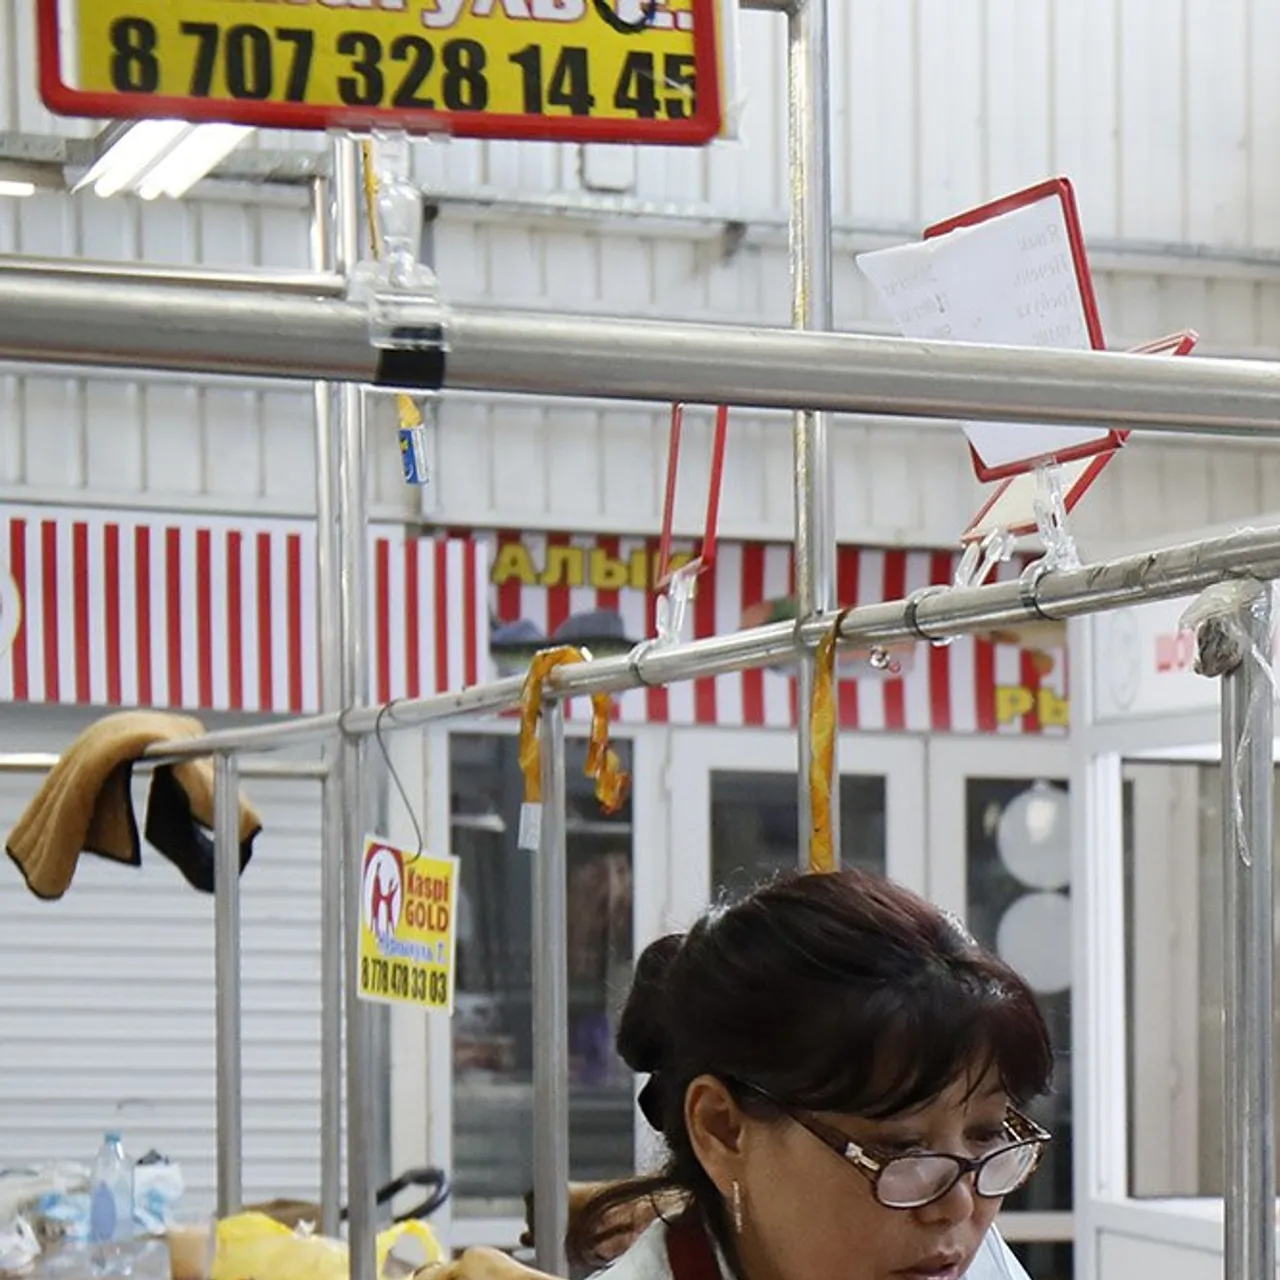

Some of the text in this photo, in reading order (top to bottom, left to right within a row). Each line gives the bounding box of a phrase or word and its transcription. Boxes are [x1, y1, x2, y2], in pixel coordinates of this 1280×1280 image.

[108, 16, 698, 121] 8 707 328 14 45
[406, 868, 449, 902] Kaspi
[405, 900, 449, 932] GOLD
[361, 955, 369, 990] 8
